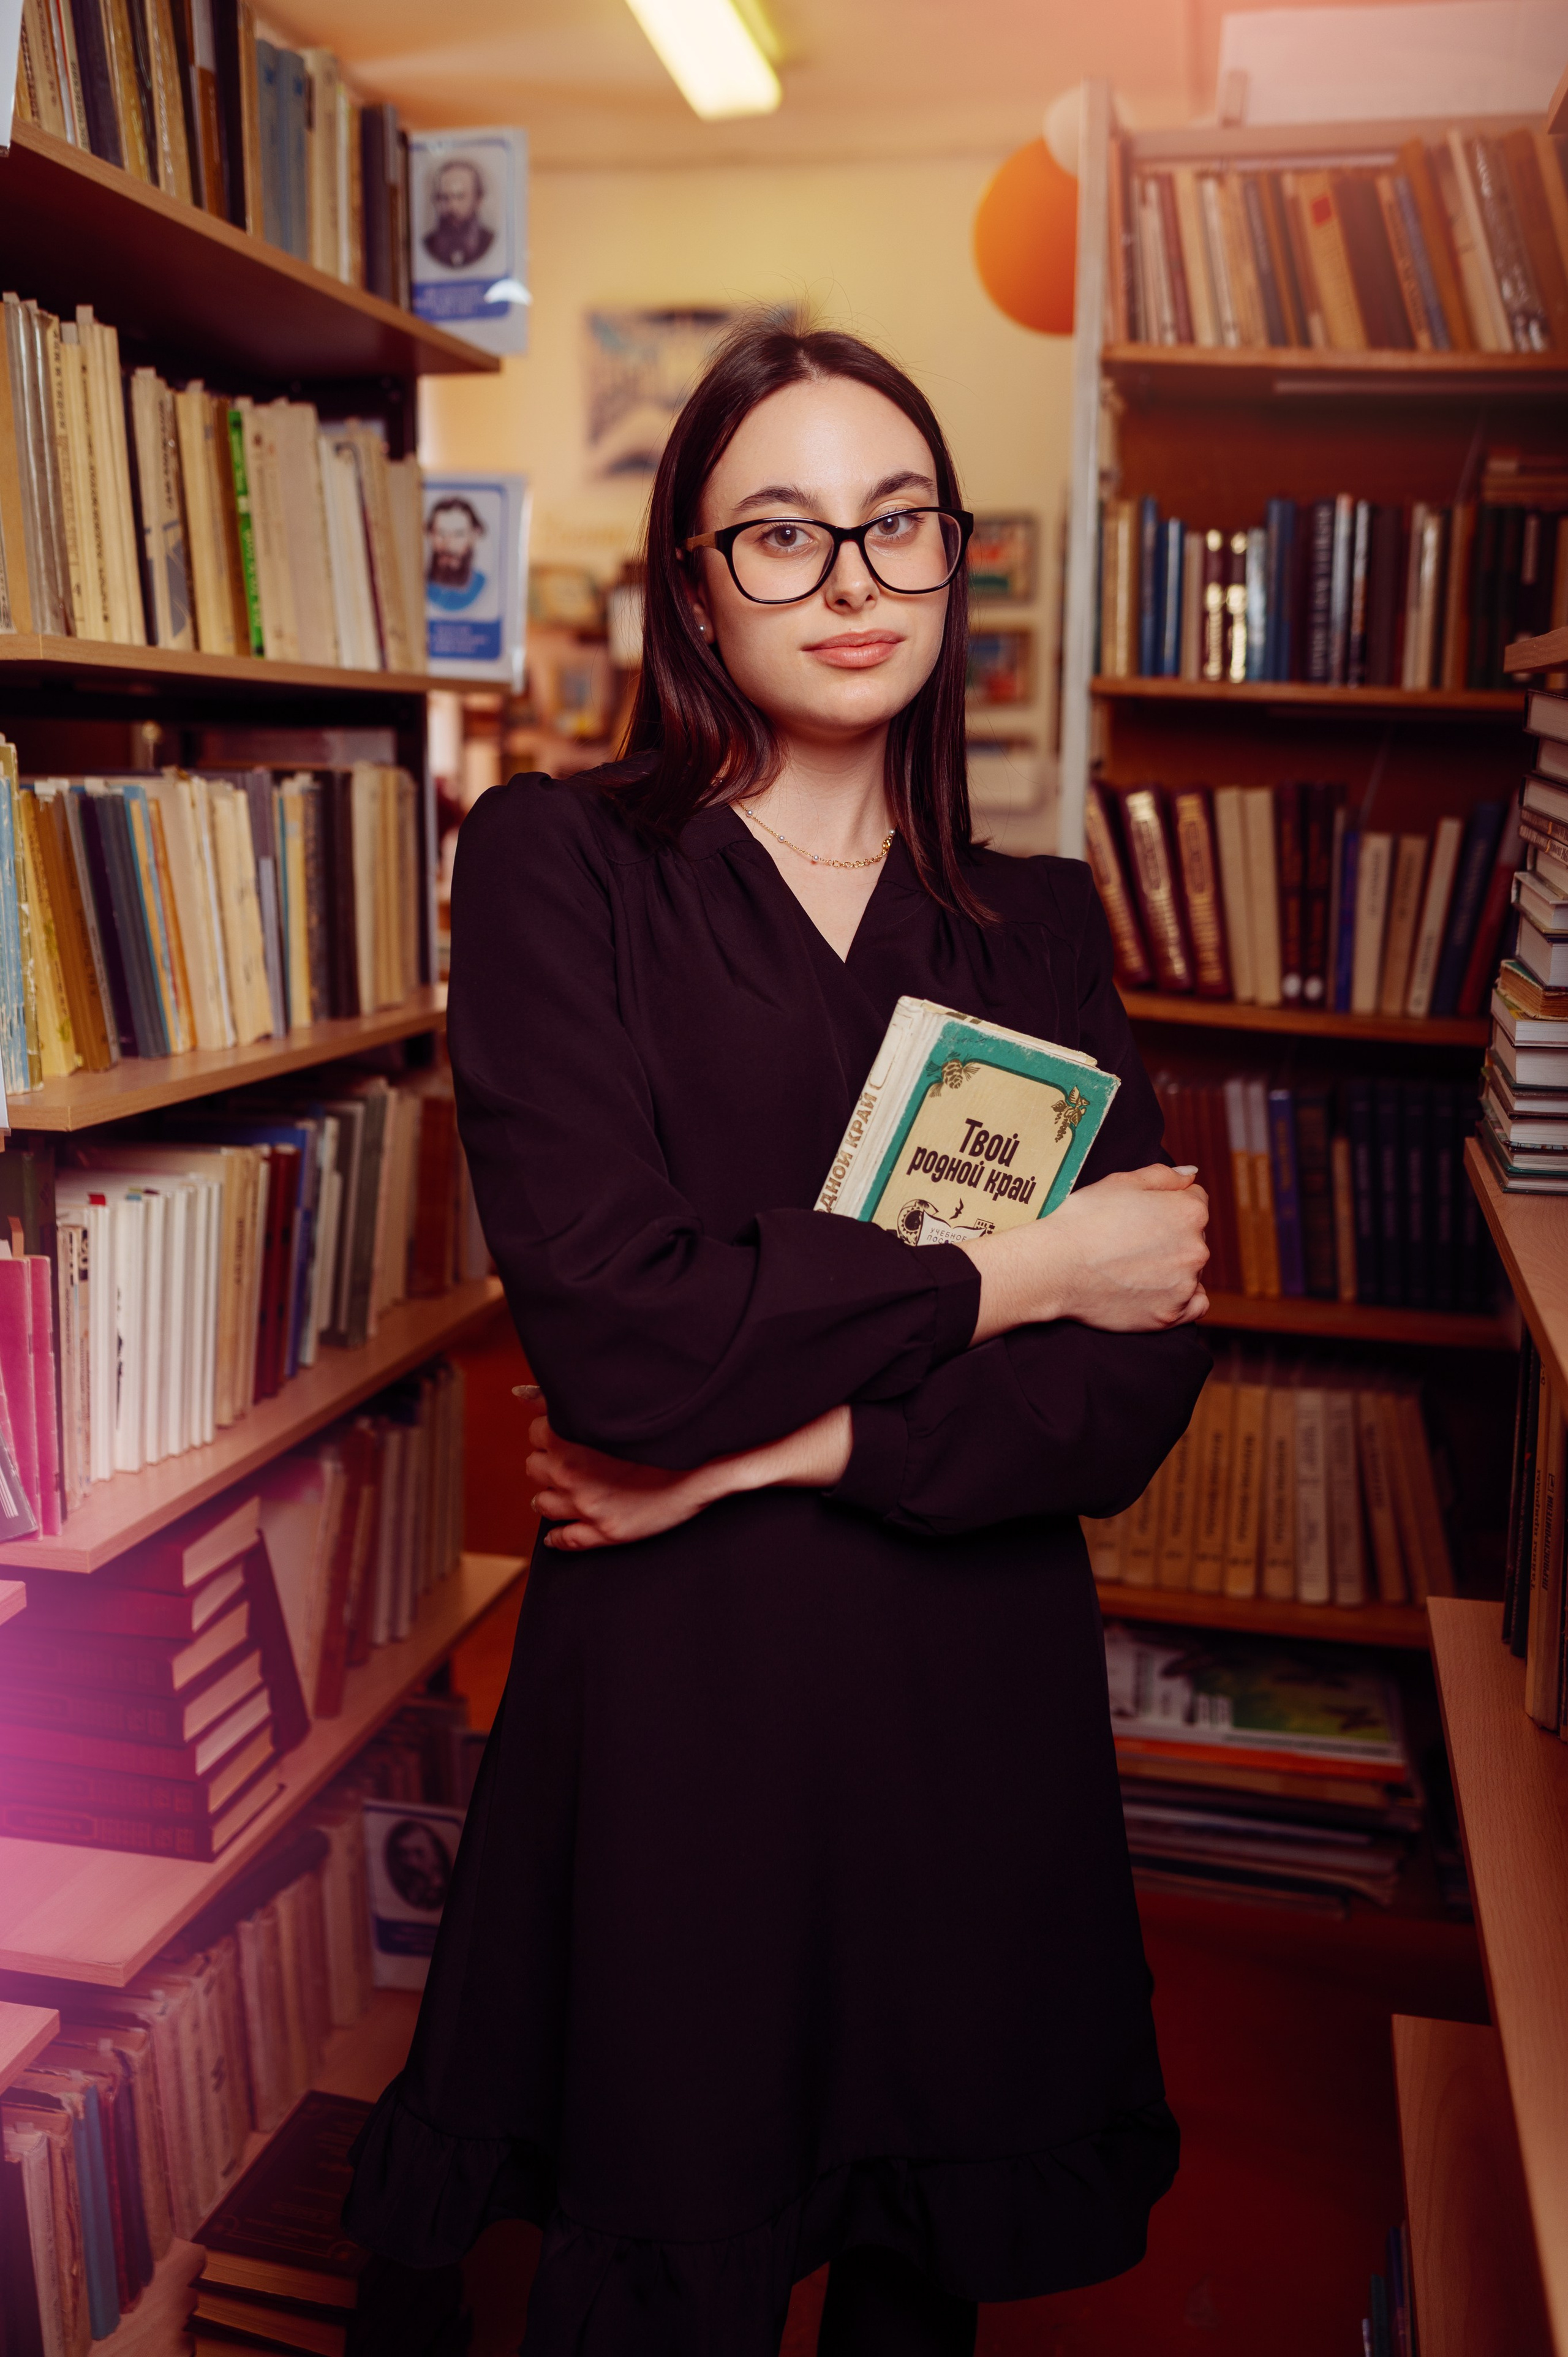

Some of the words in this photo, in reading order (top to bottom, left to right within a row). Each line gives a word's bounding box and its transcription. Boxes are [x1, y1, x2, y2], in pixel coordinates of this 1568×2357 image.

[816, 1150, 853, 1213] ДНОЙ
[845, 1092, 877, 1148] КРАЙ
[959, 1118, 1019, 1167] Твой
[907, 1145, 985, 1188] родной
[983, 1168, 1036, 1205] край
[926, 1234, 955, 1245] ПОСО
[930, 1227, 967, 1242] УЧЕБНОЕ
[1541, 1495, 1554, 1591] ПЕРВОСТРОИТЕЛИ
